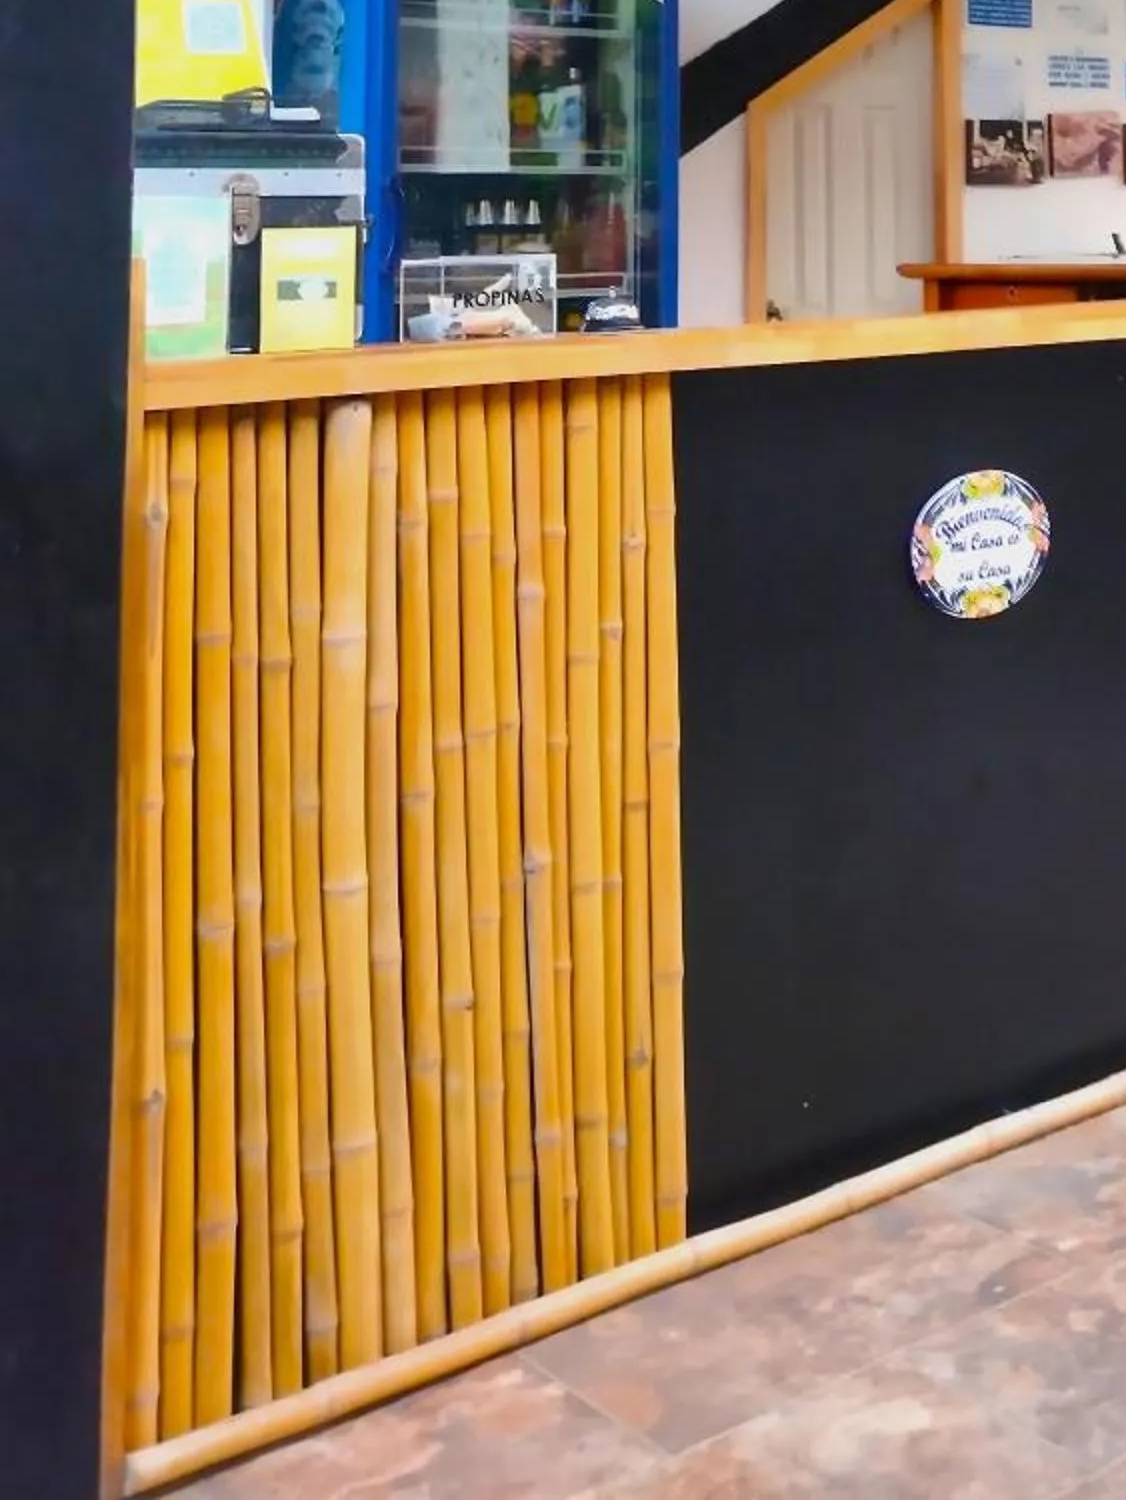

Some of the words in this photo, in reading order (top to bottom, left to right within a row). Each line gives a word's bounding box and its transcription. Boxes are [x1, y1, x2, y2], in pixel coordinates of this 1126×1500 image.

[452, 287, 545, 308] PROPINAS
[971, 532, 1003, 551] Casa
[978, 560, 1011, 580] Casa
